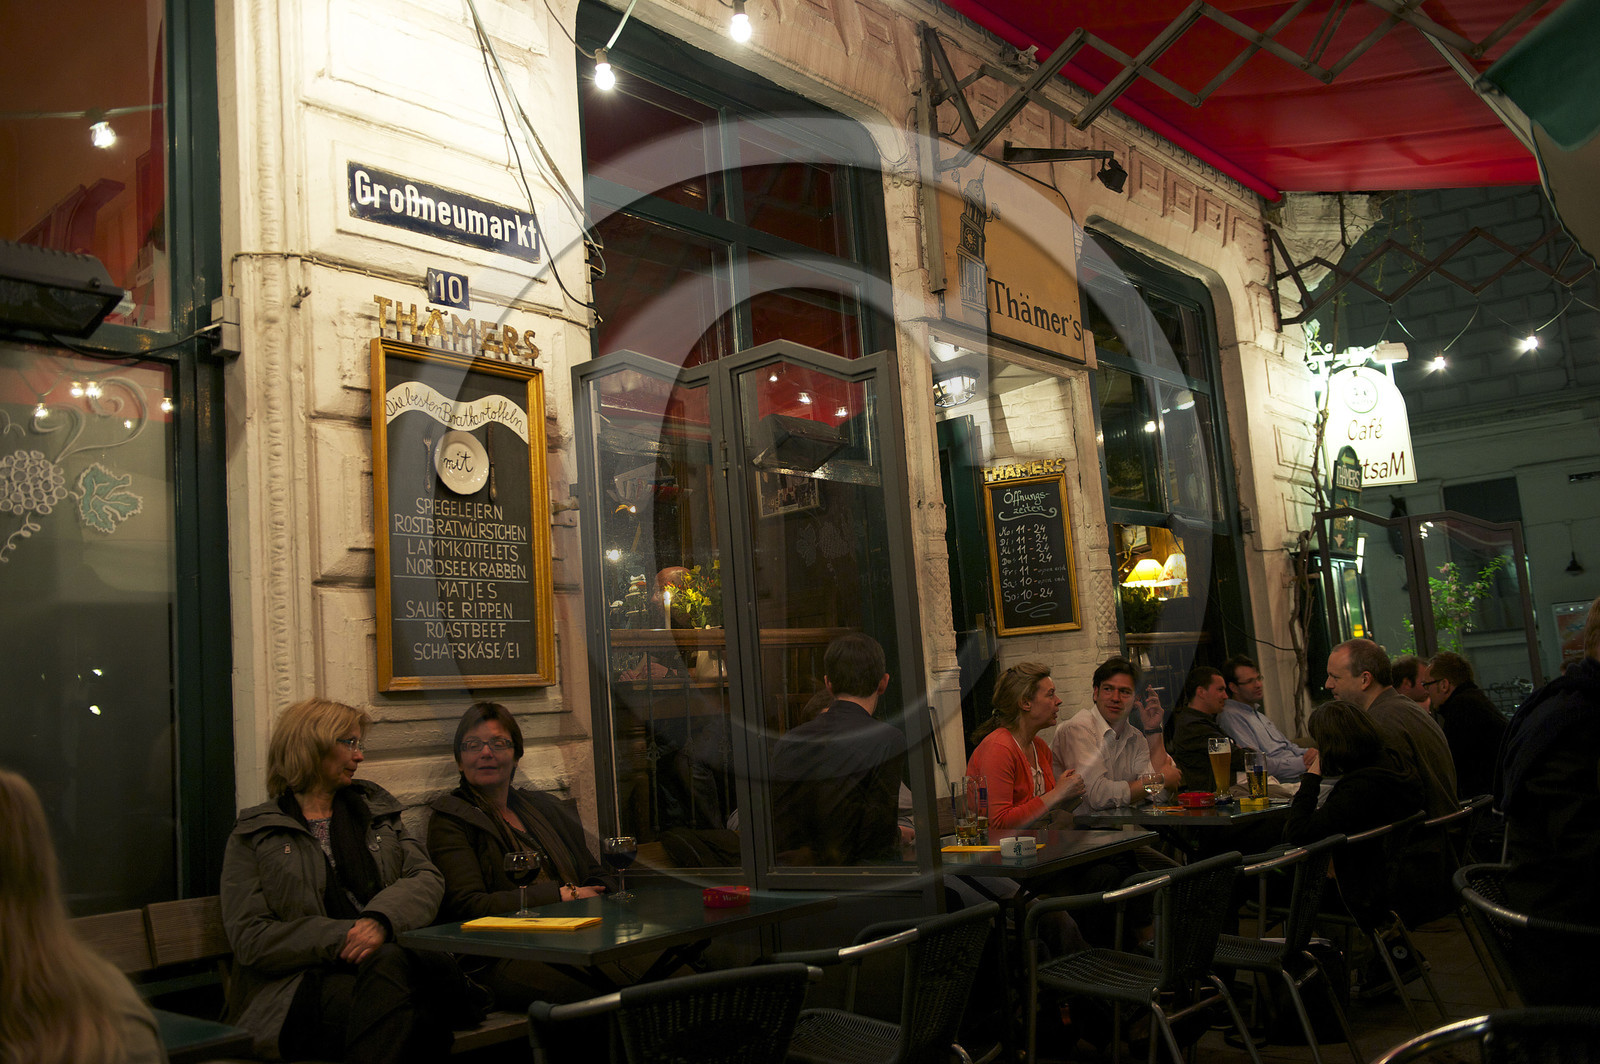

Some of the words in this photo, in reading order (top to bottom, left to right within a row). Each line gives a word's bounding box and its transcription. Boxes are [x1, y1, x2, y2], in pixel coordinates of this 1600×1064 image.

[354, 170, 537, 249] Großneumarkt
[436, 273, 463, 303] 10
[988, 277, 1082, 342] Thämer's
[1348, 417, 1383, 441] Café
[443, 451, 474, 473] mit
[416, 498, 503, 521] SPIEGELEIERN
[1013, 503, 1047, 515] zeiten
[394, 513, 527, 542] ROSTBRATWÜRSTCHEN
[407, 538, 519, 562] LAMMKOTTELETS
[406, 557, 527, 579] NORDSEEKRABBEN
[438, 581, 498, 601] MATJES
[406, 600, 455, 619] SAURE
[462, 602, 513, 619] RIPPEN
[425, 622, 507, 639] ROASTBEEF
